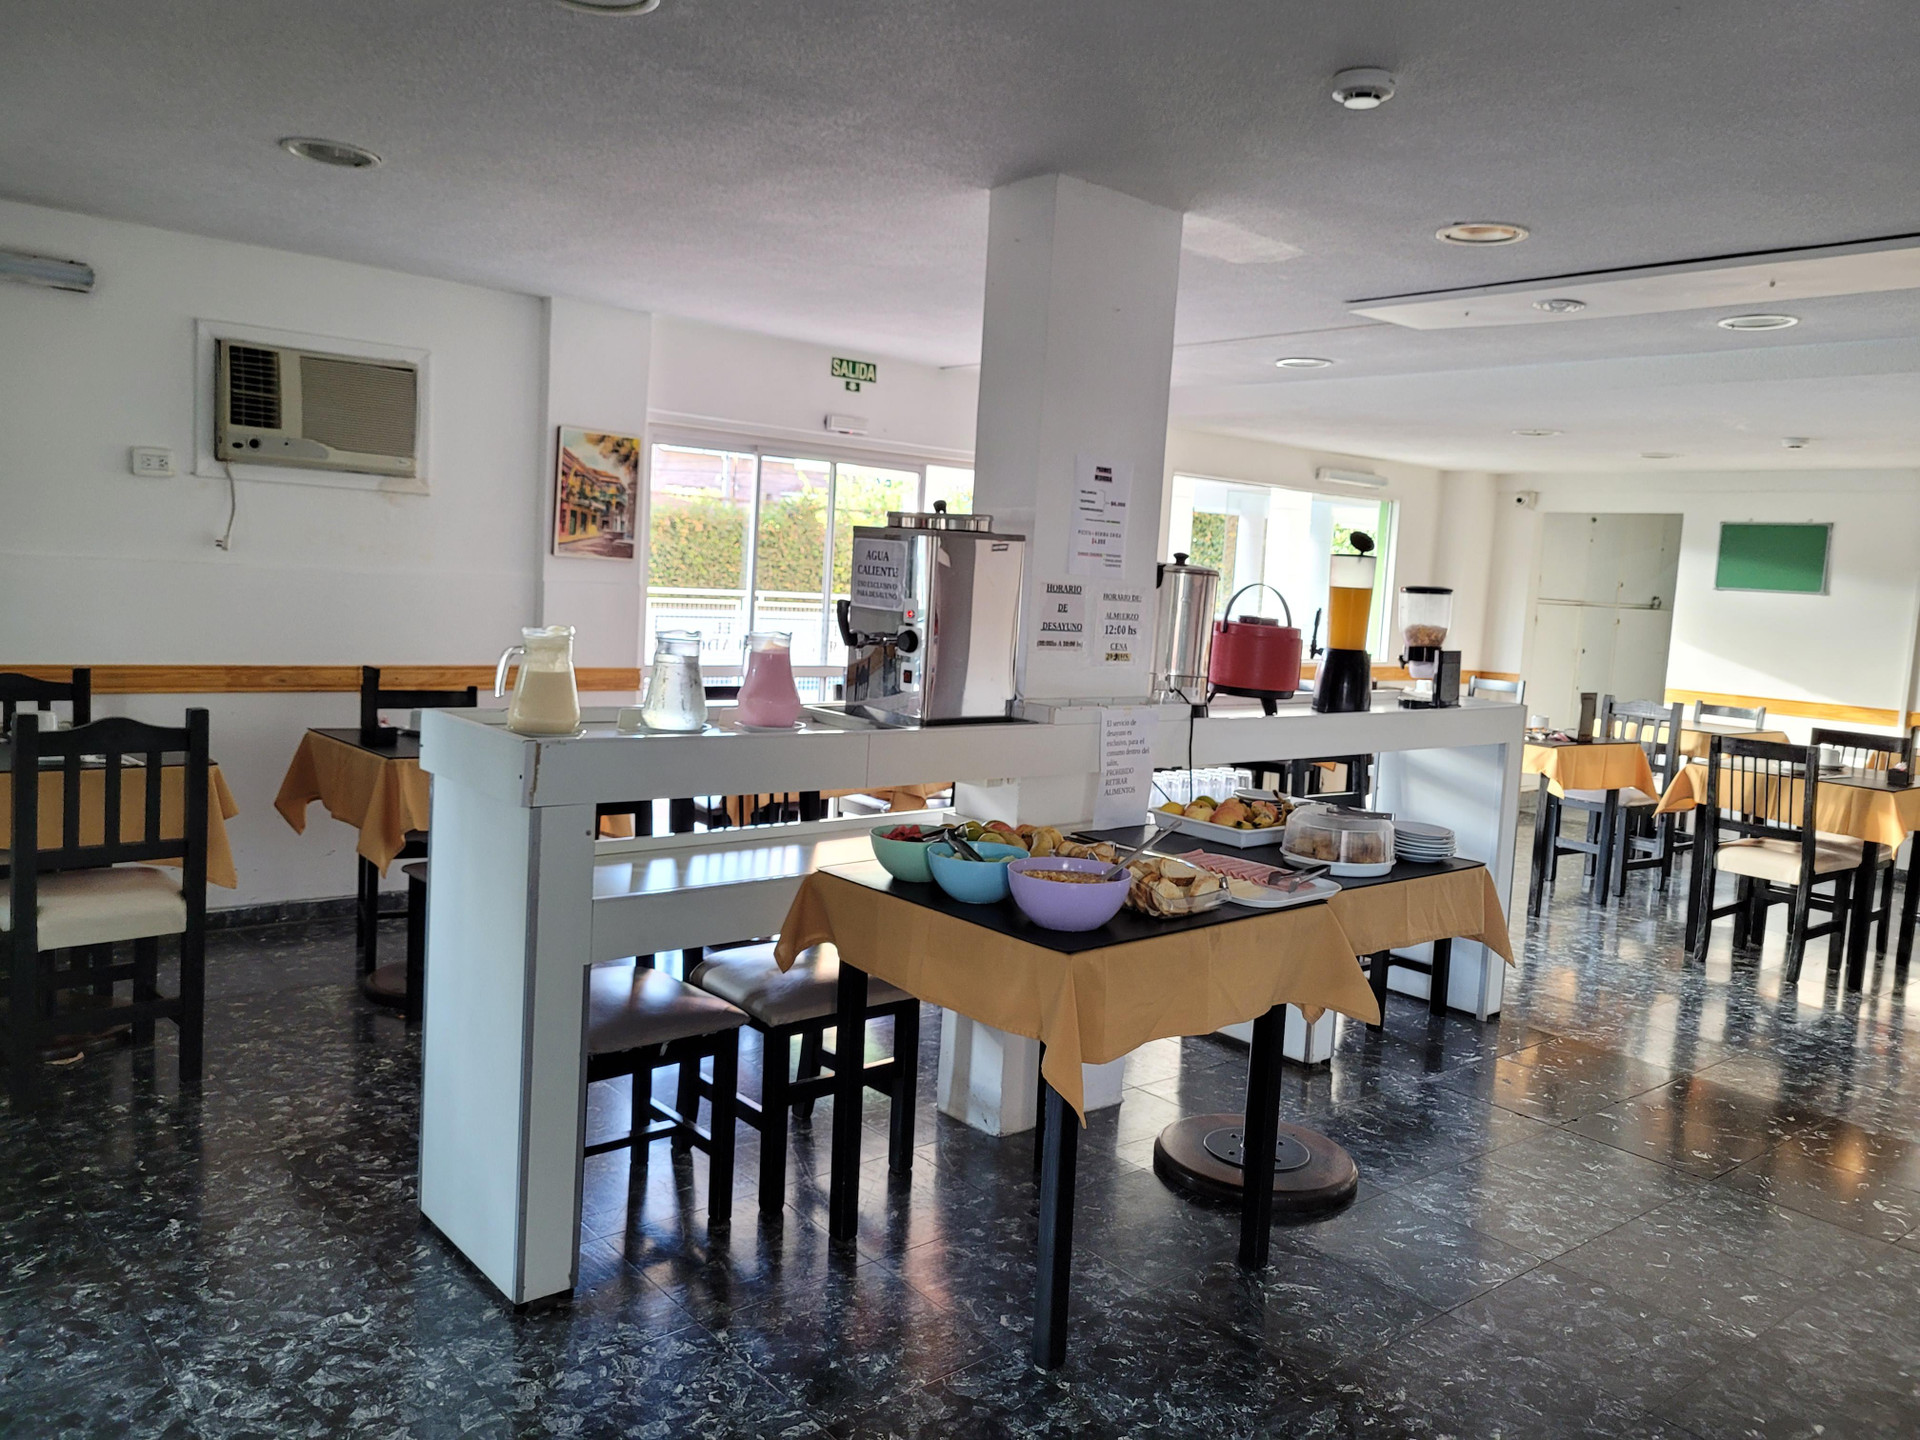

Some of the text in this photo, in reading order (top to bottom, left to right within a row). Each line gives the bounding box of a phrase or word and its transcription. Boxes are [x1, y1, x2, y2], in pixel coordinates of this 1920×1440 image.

[832, 358, 876, 382] SALIDA
[866, 550, 889, 562] AGUA
[858, 564, 898, 578] CALIENTE
[1046, 583, 1082, 595] HORARIO
[1103, 593, 1130, 602] HORARIO
[1057, 603, 1068, 613] DE
[1105, 612, 1140, 621] ALMUERZO
[1041, 620, 1082, 632] DESAYUNO
[1105, 624, 1137, 636] 12:00 hs
[1110, 642, 1128, 652] CENA
[1106, 768, 1134, 776] PROHIBIDO
[1105, 778, 1128, 786] RETIRAR
[1104, 786, 1136, 796] ALIMENTOS
